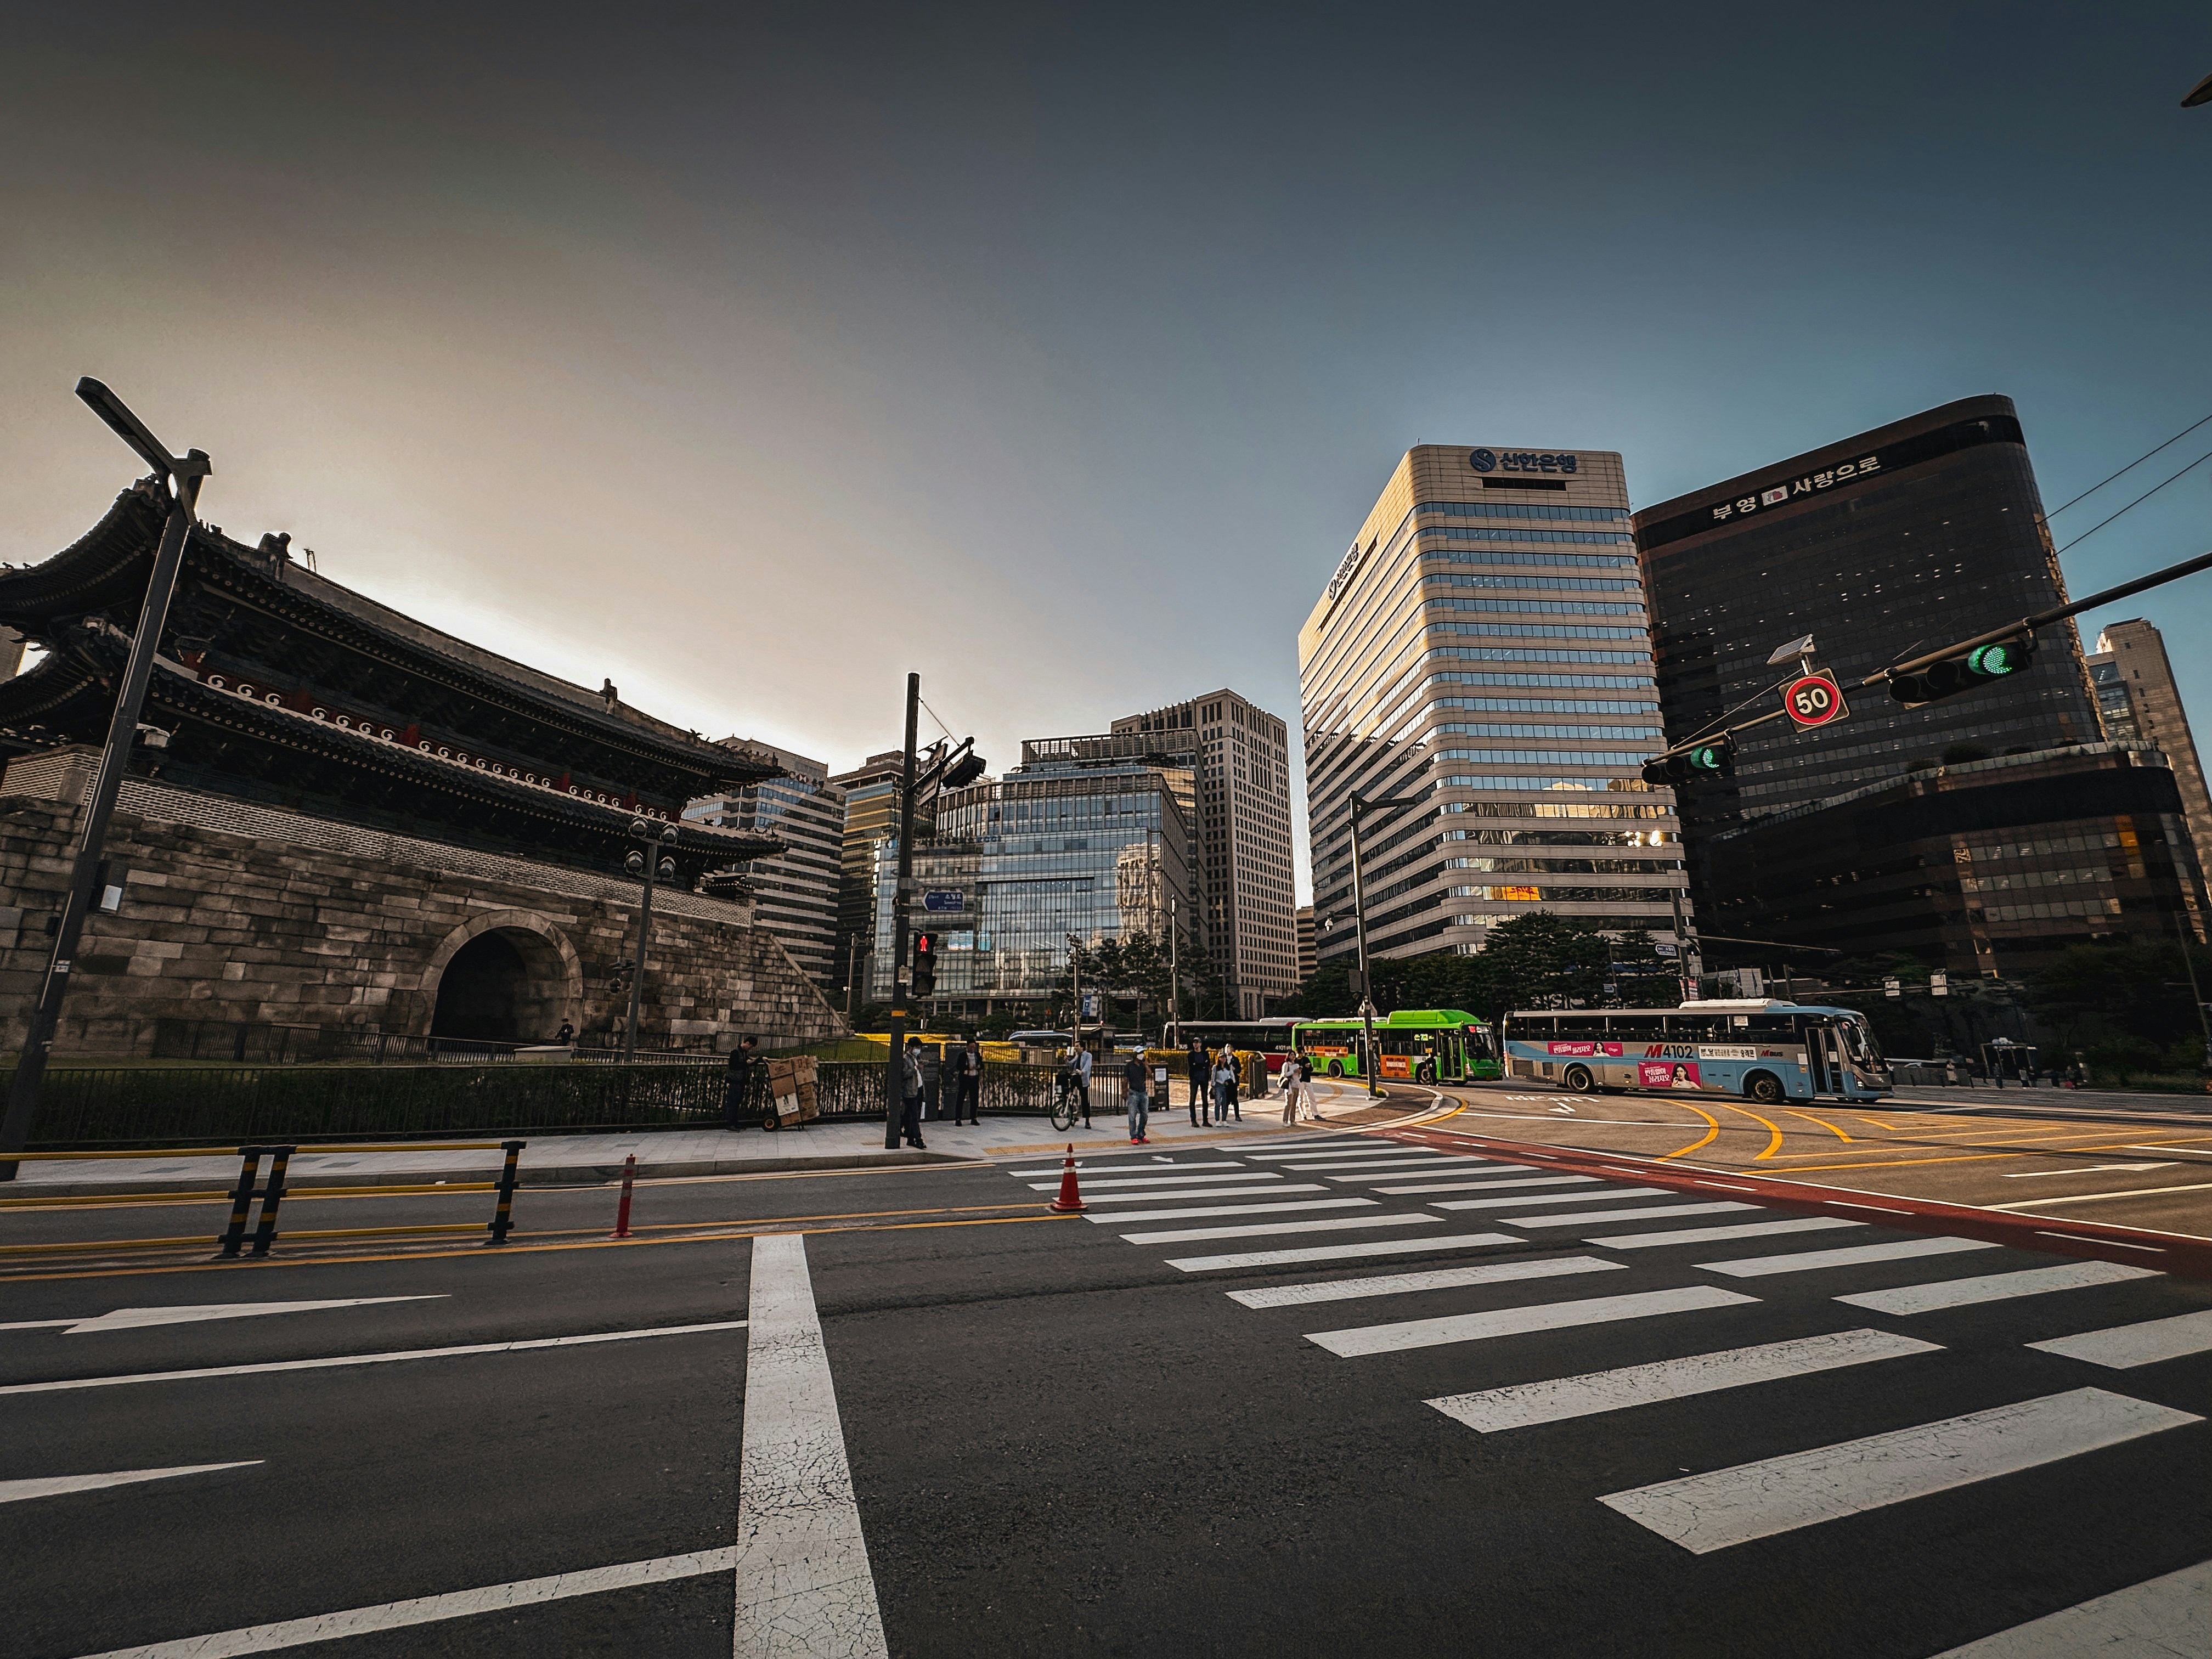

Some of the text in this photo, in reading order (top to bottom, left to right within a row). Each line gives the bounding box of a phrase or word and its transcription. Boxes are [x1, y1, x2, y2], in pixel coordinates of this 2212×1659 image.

[1500, 452, 1577, 473] 신한은행
[1792, 456, 1881, 495] 사랑으로
[1795, 688, 1829, 714] 50
